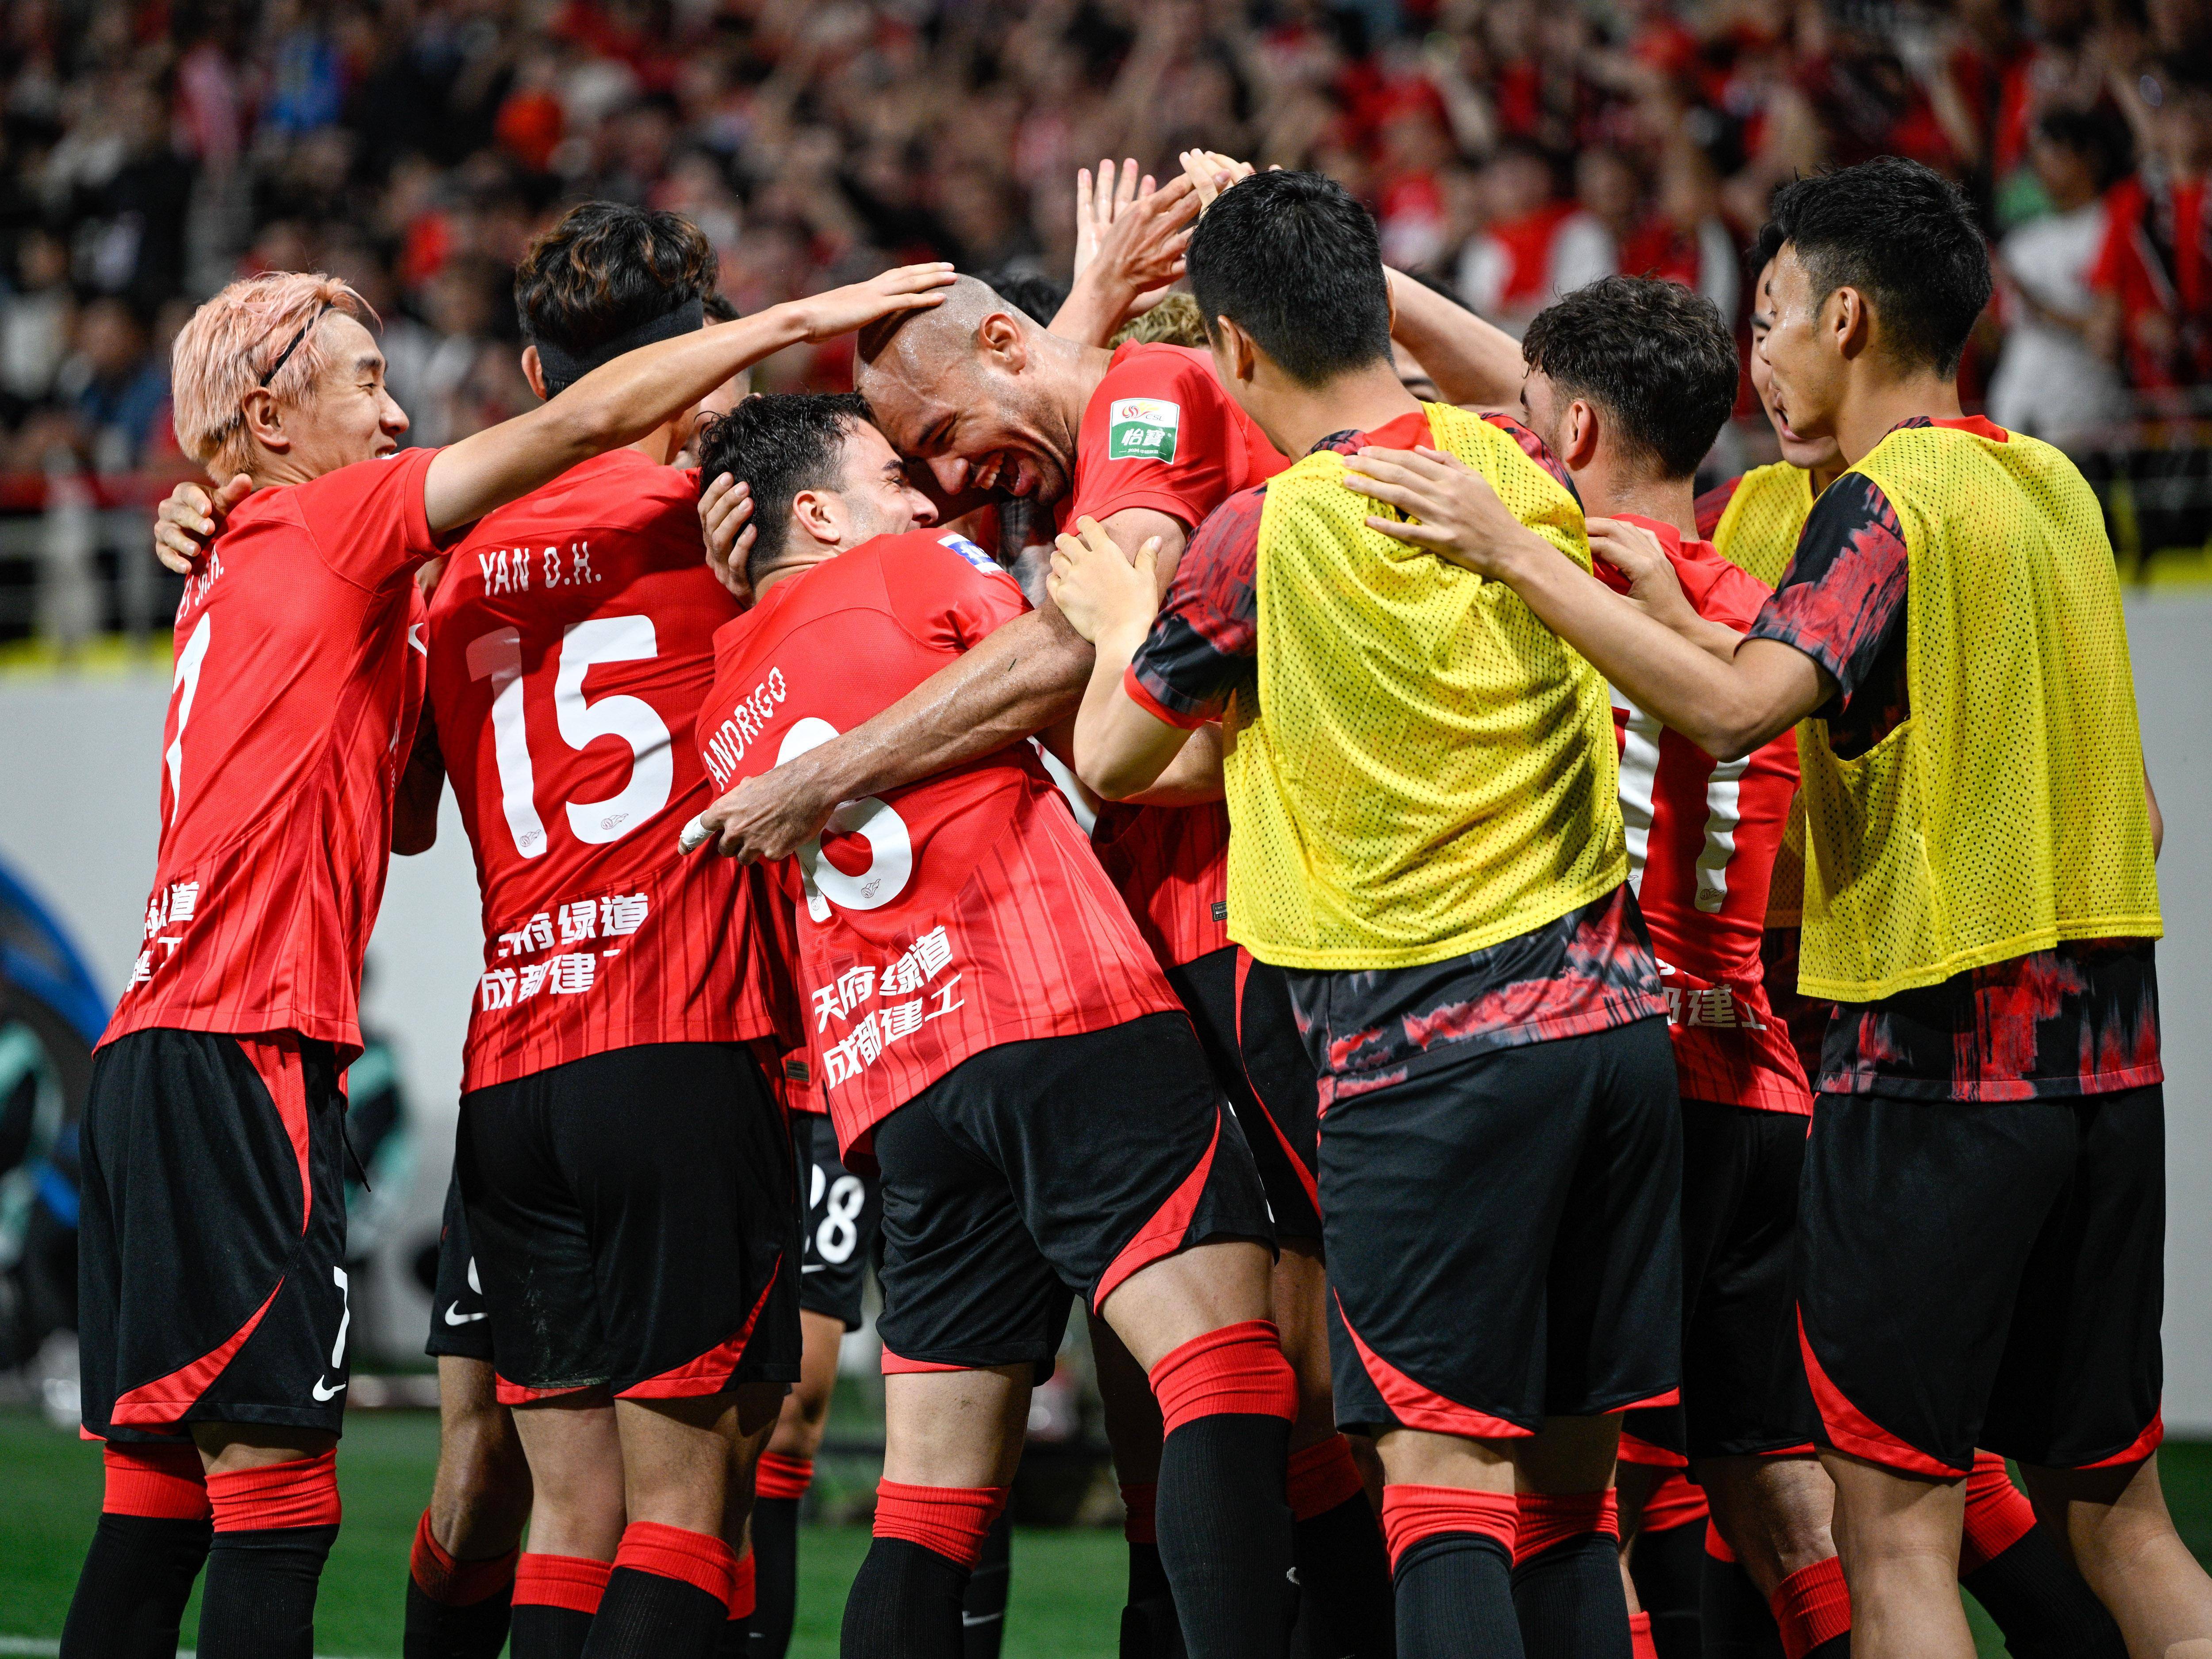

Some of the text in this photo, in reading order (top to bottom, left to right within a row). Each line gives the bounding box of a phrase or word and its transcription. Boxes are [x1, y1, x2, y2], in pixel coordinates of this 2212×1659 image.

[1121, 428, 1165, 447] 怡寶
[478, 547, 530, 597] YAN
[466, 614, 673, 859] 15
[703, 666, 786, 792] ANDRIGO
[498, 892, 649, 957] 府绿道
[481, 949, 621, 1012] 成都建
[812, 925, 953, 1034] 天府绿道
[822, 972, 965, 1090] 成都建工
[332, 1266, 350, 1369] 7
